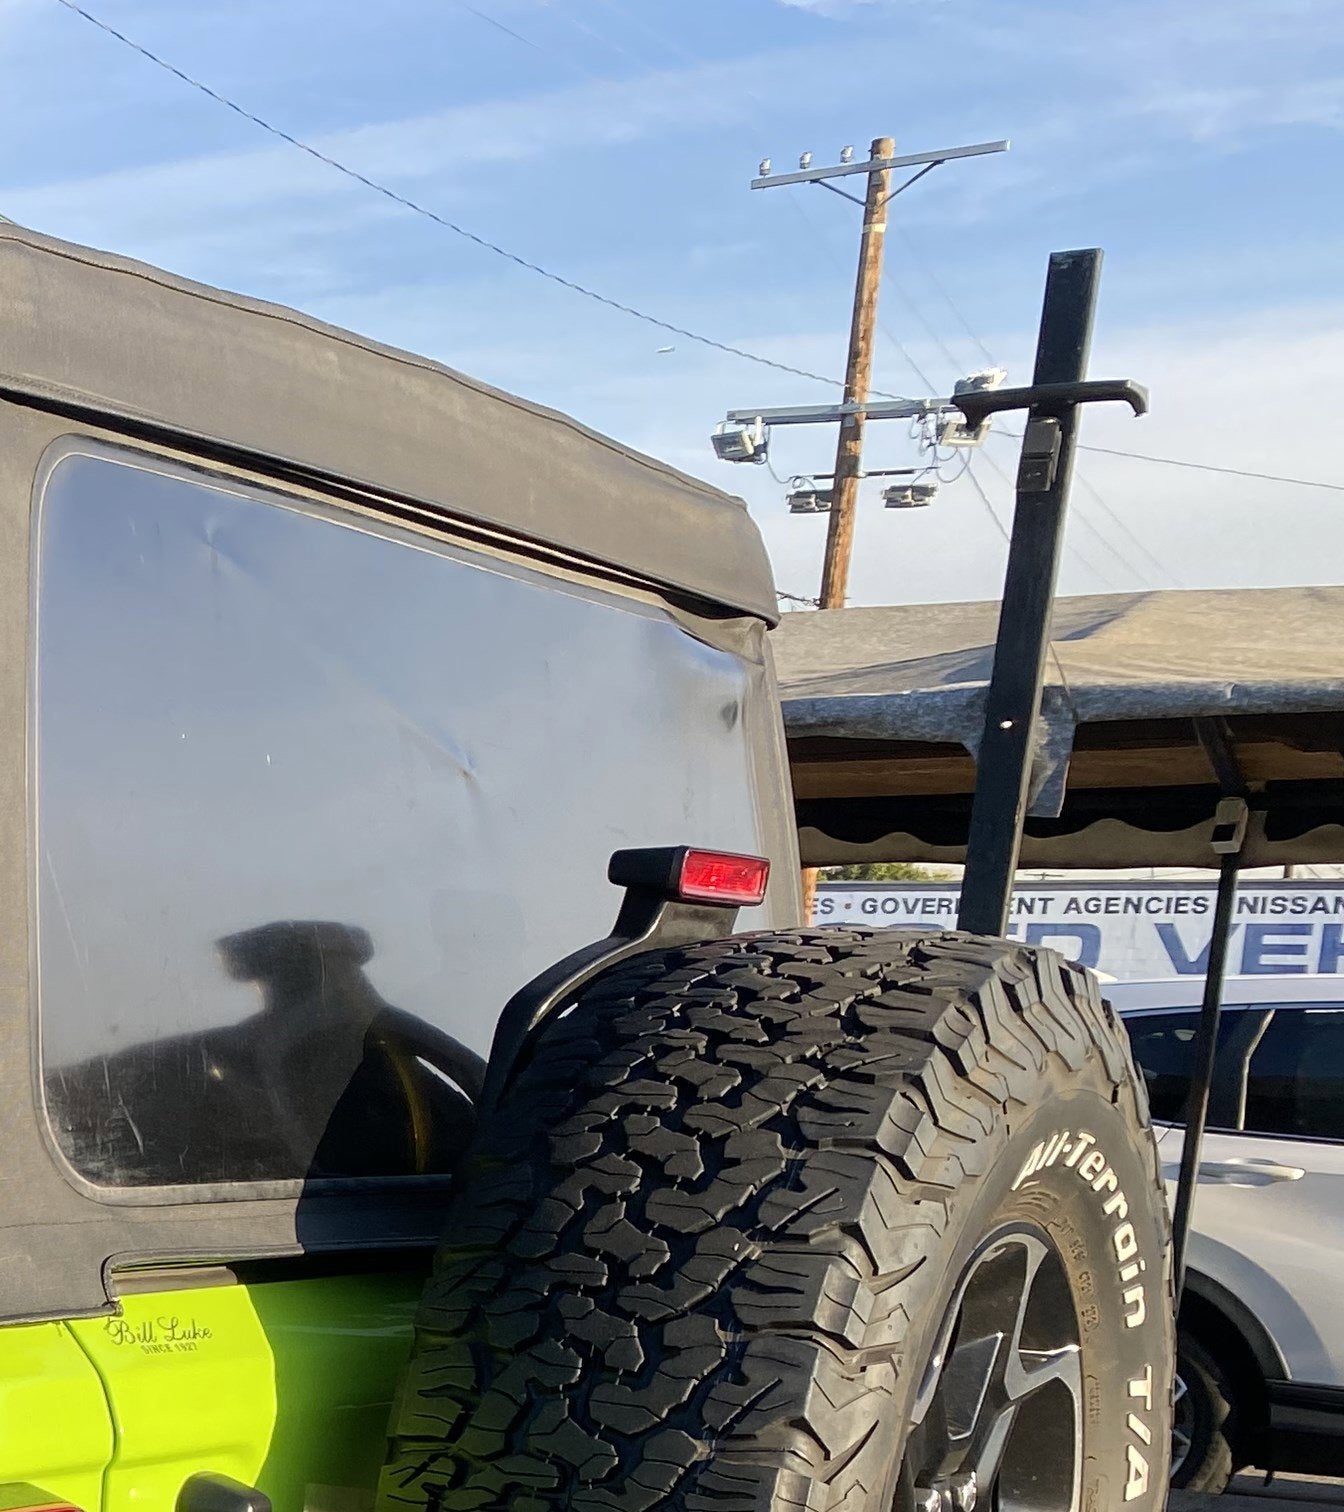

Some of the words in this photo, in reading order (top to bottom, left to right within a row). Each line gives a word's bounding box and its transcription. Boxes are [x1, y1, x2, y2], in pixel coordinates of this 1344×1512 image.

[862, 896, 1054, 915] GOVERNT
[1063, 896, 1209, 915] AGENCIES
[1011, 1131, 1146, 1329] All-Terrain
[1124, 1363, 1152, 1502] T/A
[103, 1317, 157, 1345] Bill
[157, 1316, 213, 1342] Luke
[140, 1344, 173, 1355] SINCE
